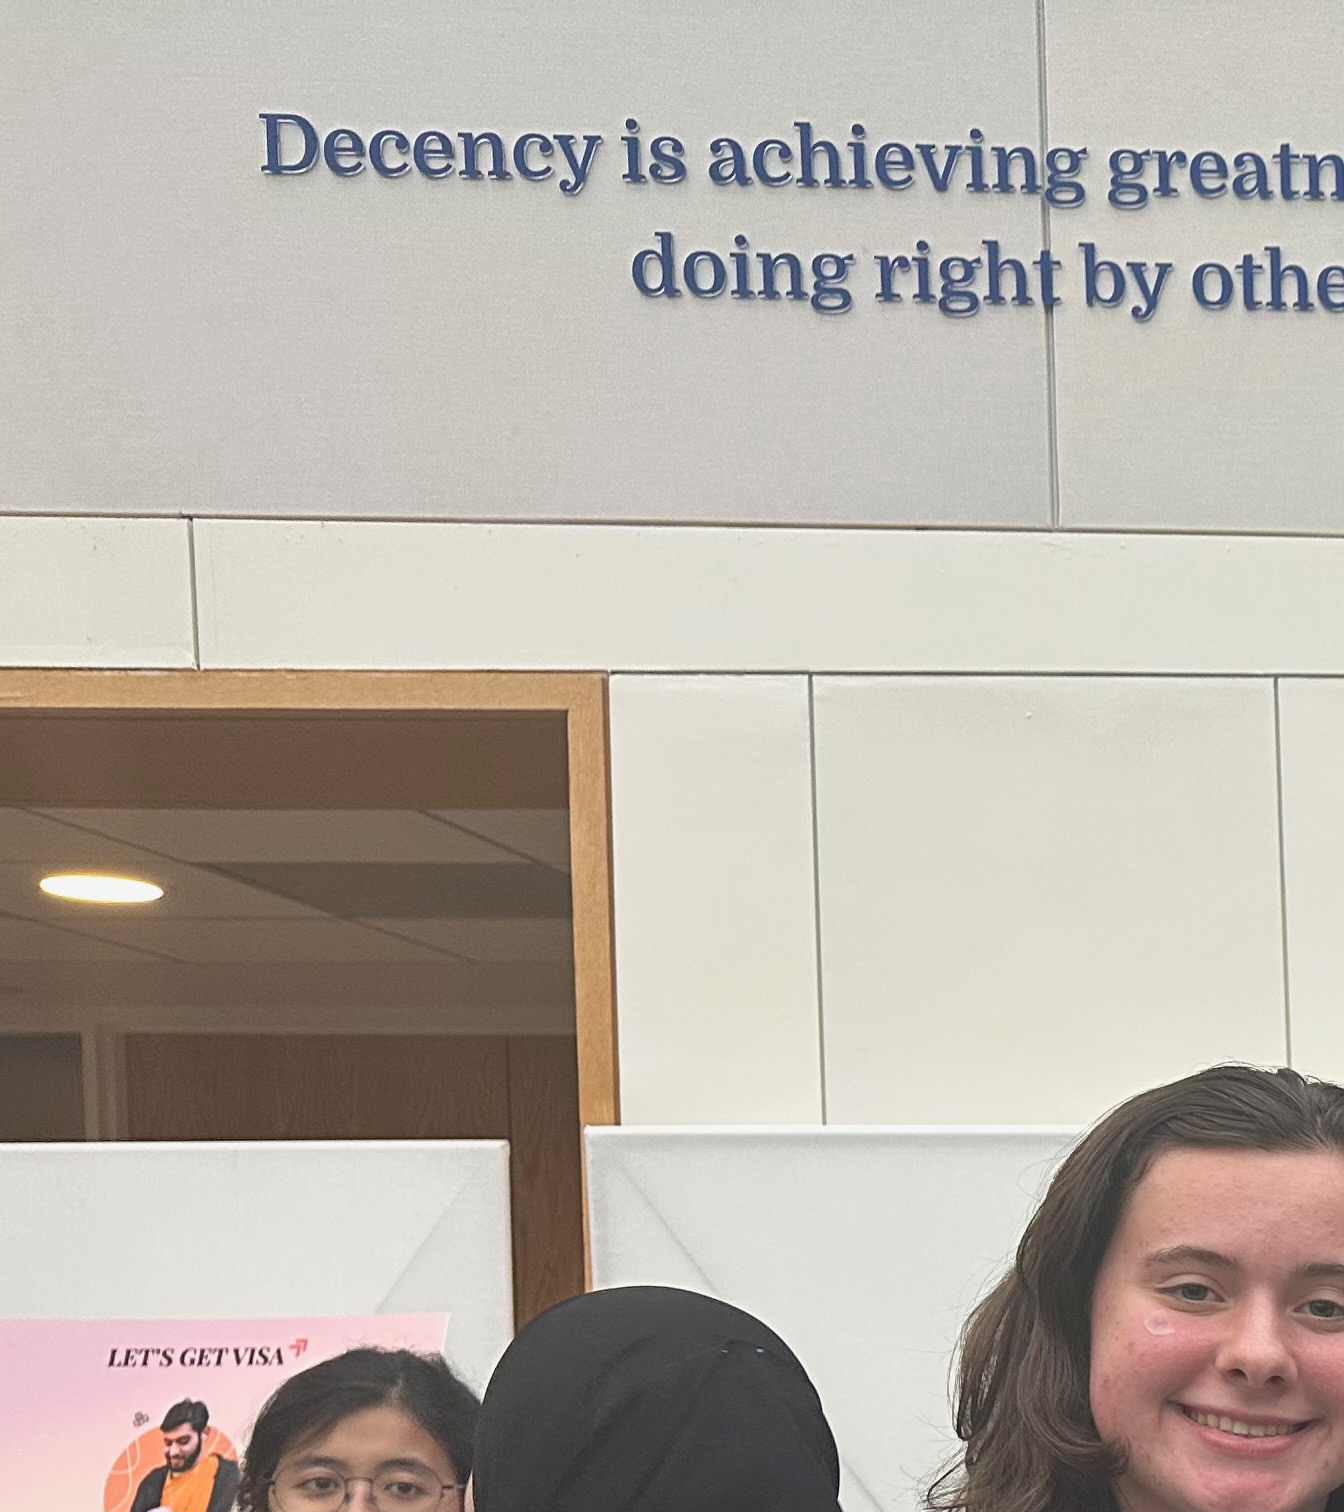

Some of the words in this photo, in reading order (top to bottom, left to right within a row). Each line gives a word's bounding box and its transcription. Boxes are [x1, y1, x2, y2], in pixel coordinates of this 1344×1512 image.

[259, 112, 602, 195] Decency
[620, 119, 687, 184] is
[709, 122, 1086, 208] achieving
[631, 232, 854, 314] doing
[874, 240, 1061, 316] right
[1078, 243, 1173, 320] by
[108, 1348, 174, 1368] LET'S
[179, 1347, 229, 1367] GET
[232, 1346, 284, 1366] VISA
